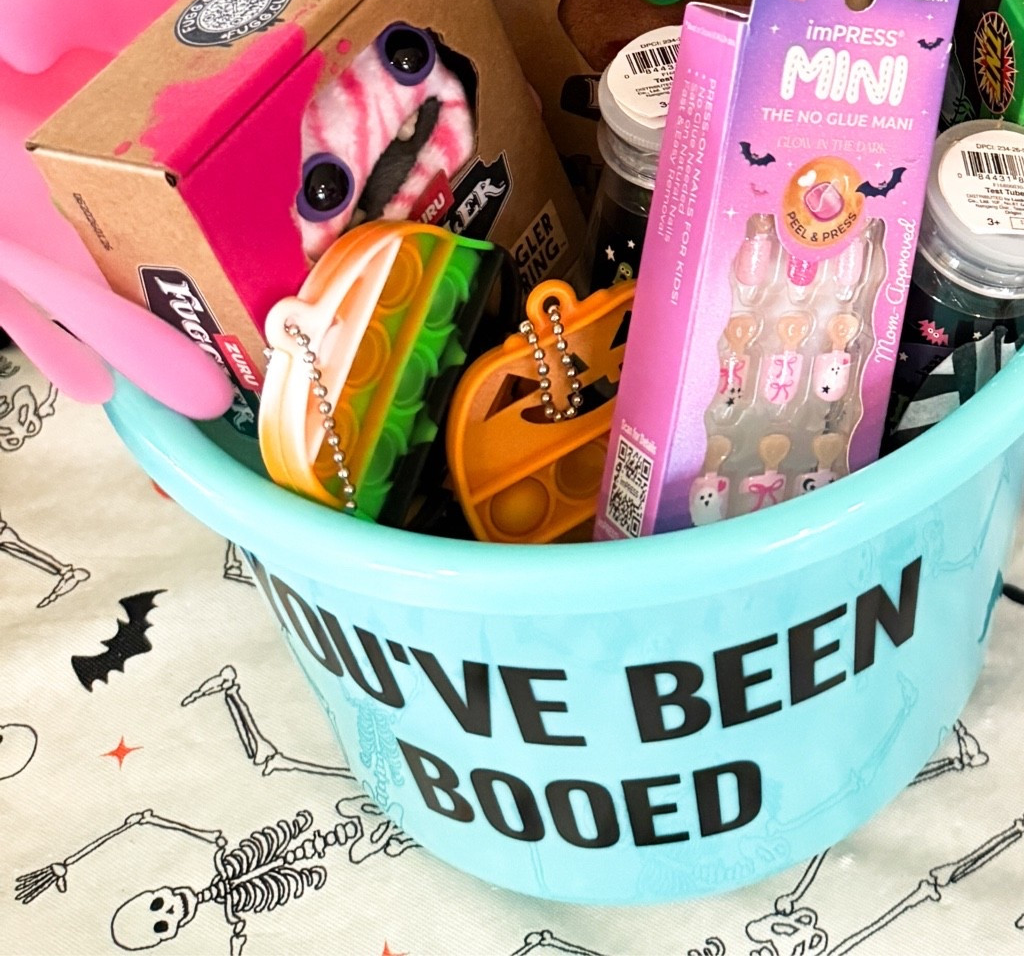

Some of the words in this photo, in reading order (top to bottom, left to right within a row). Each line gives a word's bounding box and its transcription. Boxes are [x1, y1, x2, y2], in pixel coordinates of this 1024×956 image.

[181, 3, 203, 34] FUGG
[226, 13, 272, 40] FUGG
[645, 65, 675, 75] 8443
[780, 45, 908, 106] MINI
[678, 79, 690, 112] Fast
[686, 83, 698, 117] Safe
[694, 86, 707, 109] No
[676, 117, 685, 128] &
[682, 118, 692, 137] on
[689, 110, 702, 149] Glue
[697, 78, 717, 165] PRESS-ON
[762, 107, 794, 123] THE
[796, 109, 823, 124] NO
[826, 111, 868, 128] GLUE
[872, 114, 913, 131] MANI
[668, 130, 682, 166] Easy
[671, 140, 690, 200] Natural
[678, 152, 695, 215] Needed
[656, 168, 675, 238] Removal
[686, 167, 701, 218] NAILS
[985, 187, 1004, 195] Test
[664, 203, 678, 245] Nails
[679, 221, 691, 258] FOR
[786, 210, 807, 243] PEEL
[810, 231, 819, 243] &
[821, 210, 857, 243] PRESS
[987, 217, 1001, 226] 3+
[874, 217, 917, 364] Mom-Approved
[224, 341, 259, 388] ZURU
[626, 555, 923, 743] BEEN
[396, 738, 762, 849] BOOED
